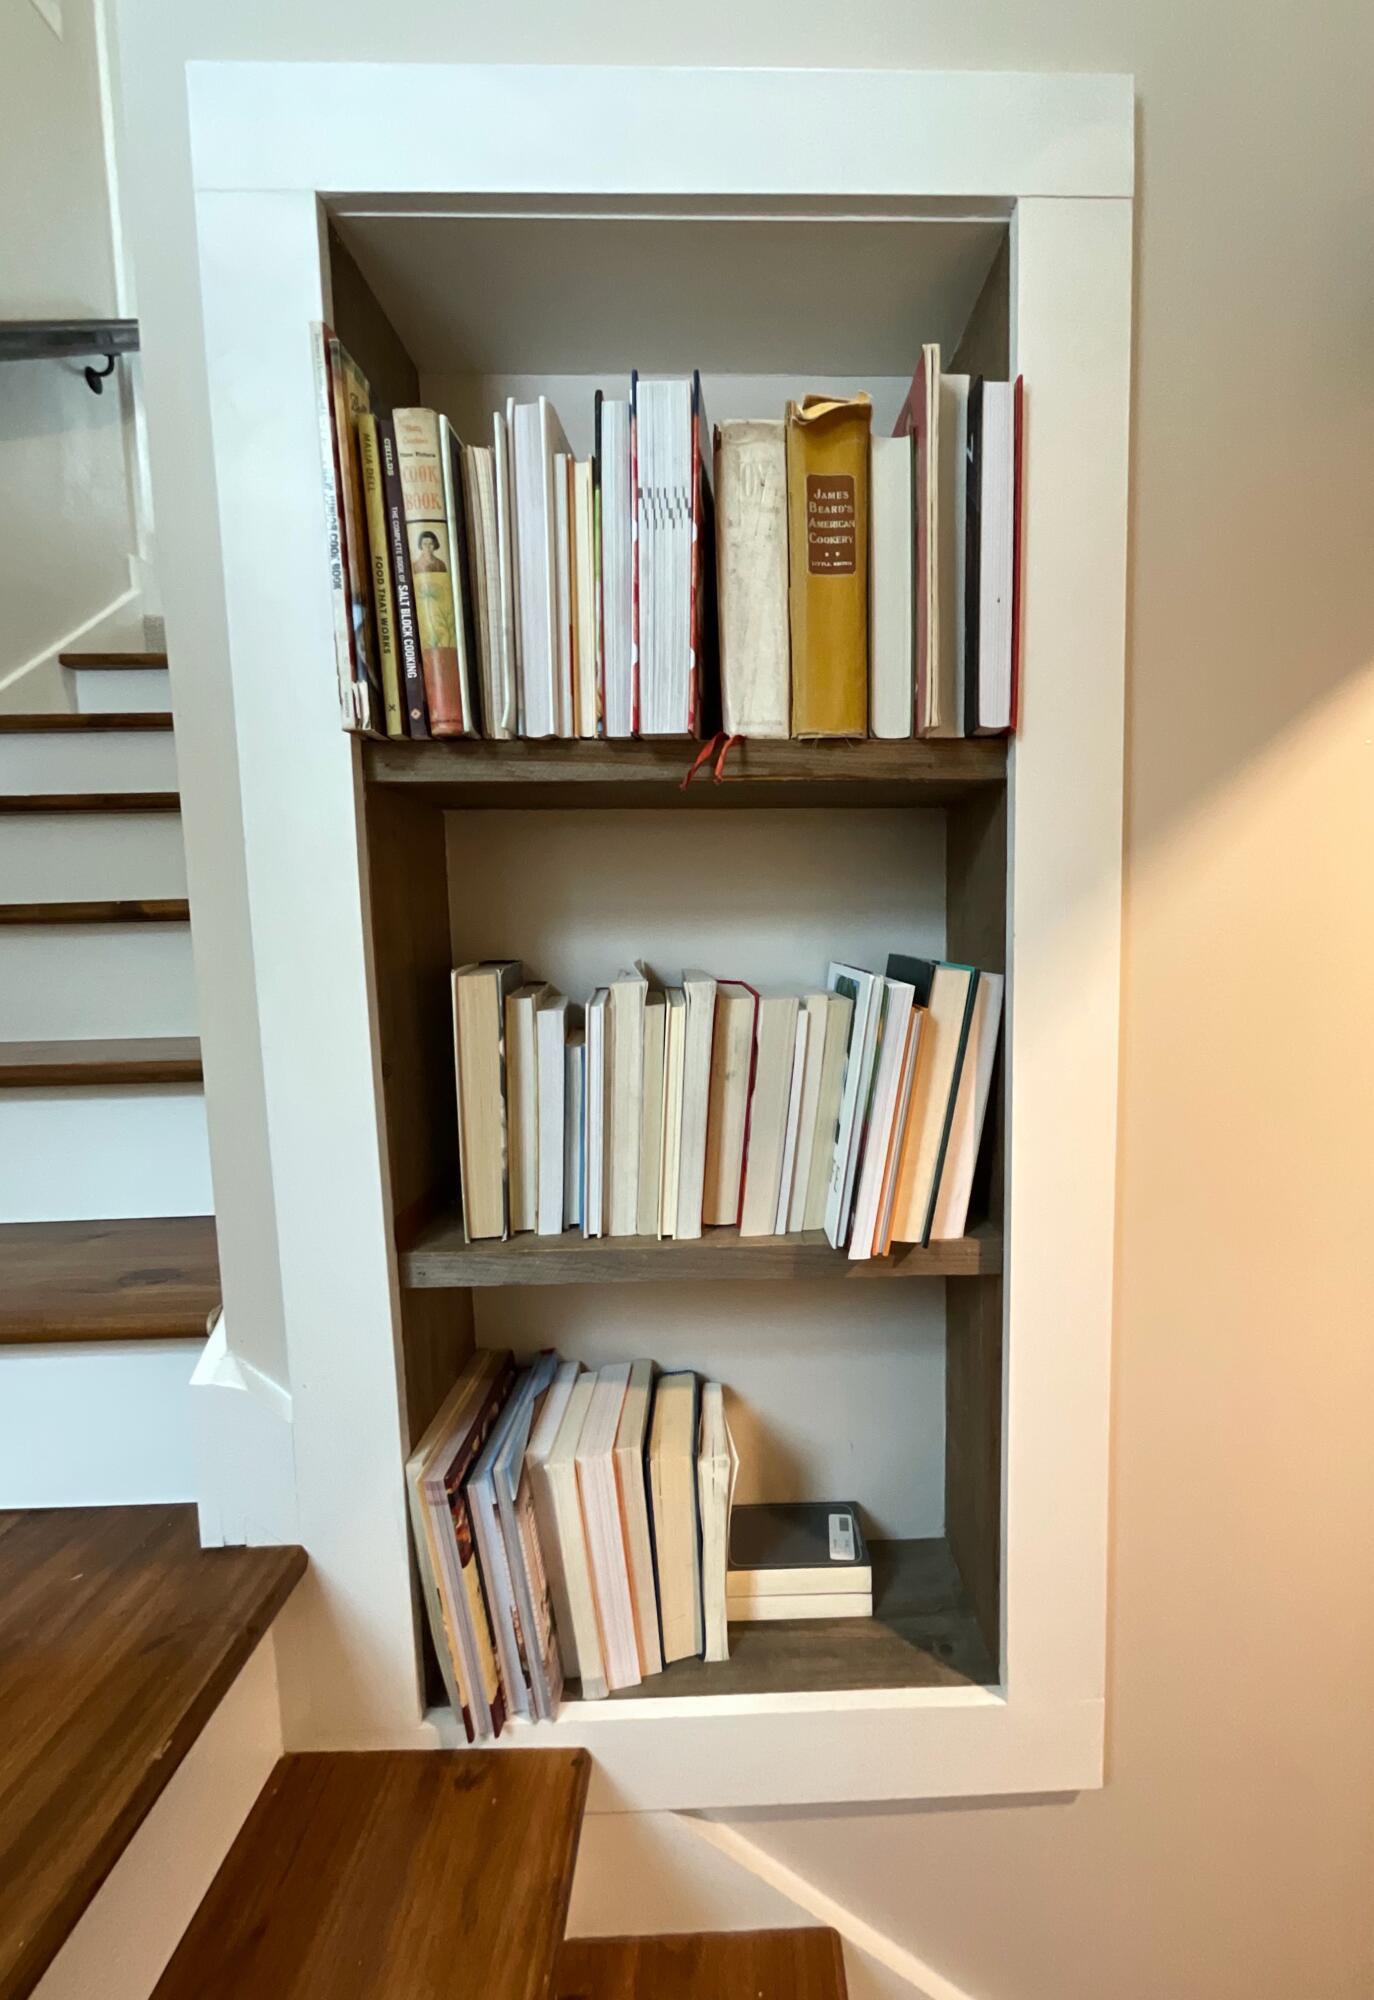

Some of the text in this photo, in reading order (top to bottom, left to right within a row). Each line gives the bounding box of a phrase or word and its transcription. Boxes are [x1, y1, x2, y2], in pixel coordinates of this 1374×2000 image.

[403, 464, 439, 482] COOK
[405, 492, 442, 510] BOOK
[814, 488, 849, 500] JAMES
[809, 501, 853, 514] BEARD'S
[809, 517, 855, 529] AMERICAN
[392, 520, 403, 555] COMPLETE
[809, 532, 853, 544] COOKERY
[331, 563, 342, 591] BOOK
[374, 555, 392, 655] FOOD THAT WORKS
[397, 584, 410, 606] SALT
[400, 608, 413, 637] BLOCK
[403, 638, 417, 679] COOKING
